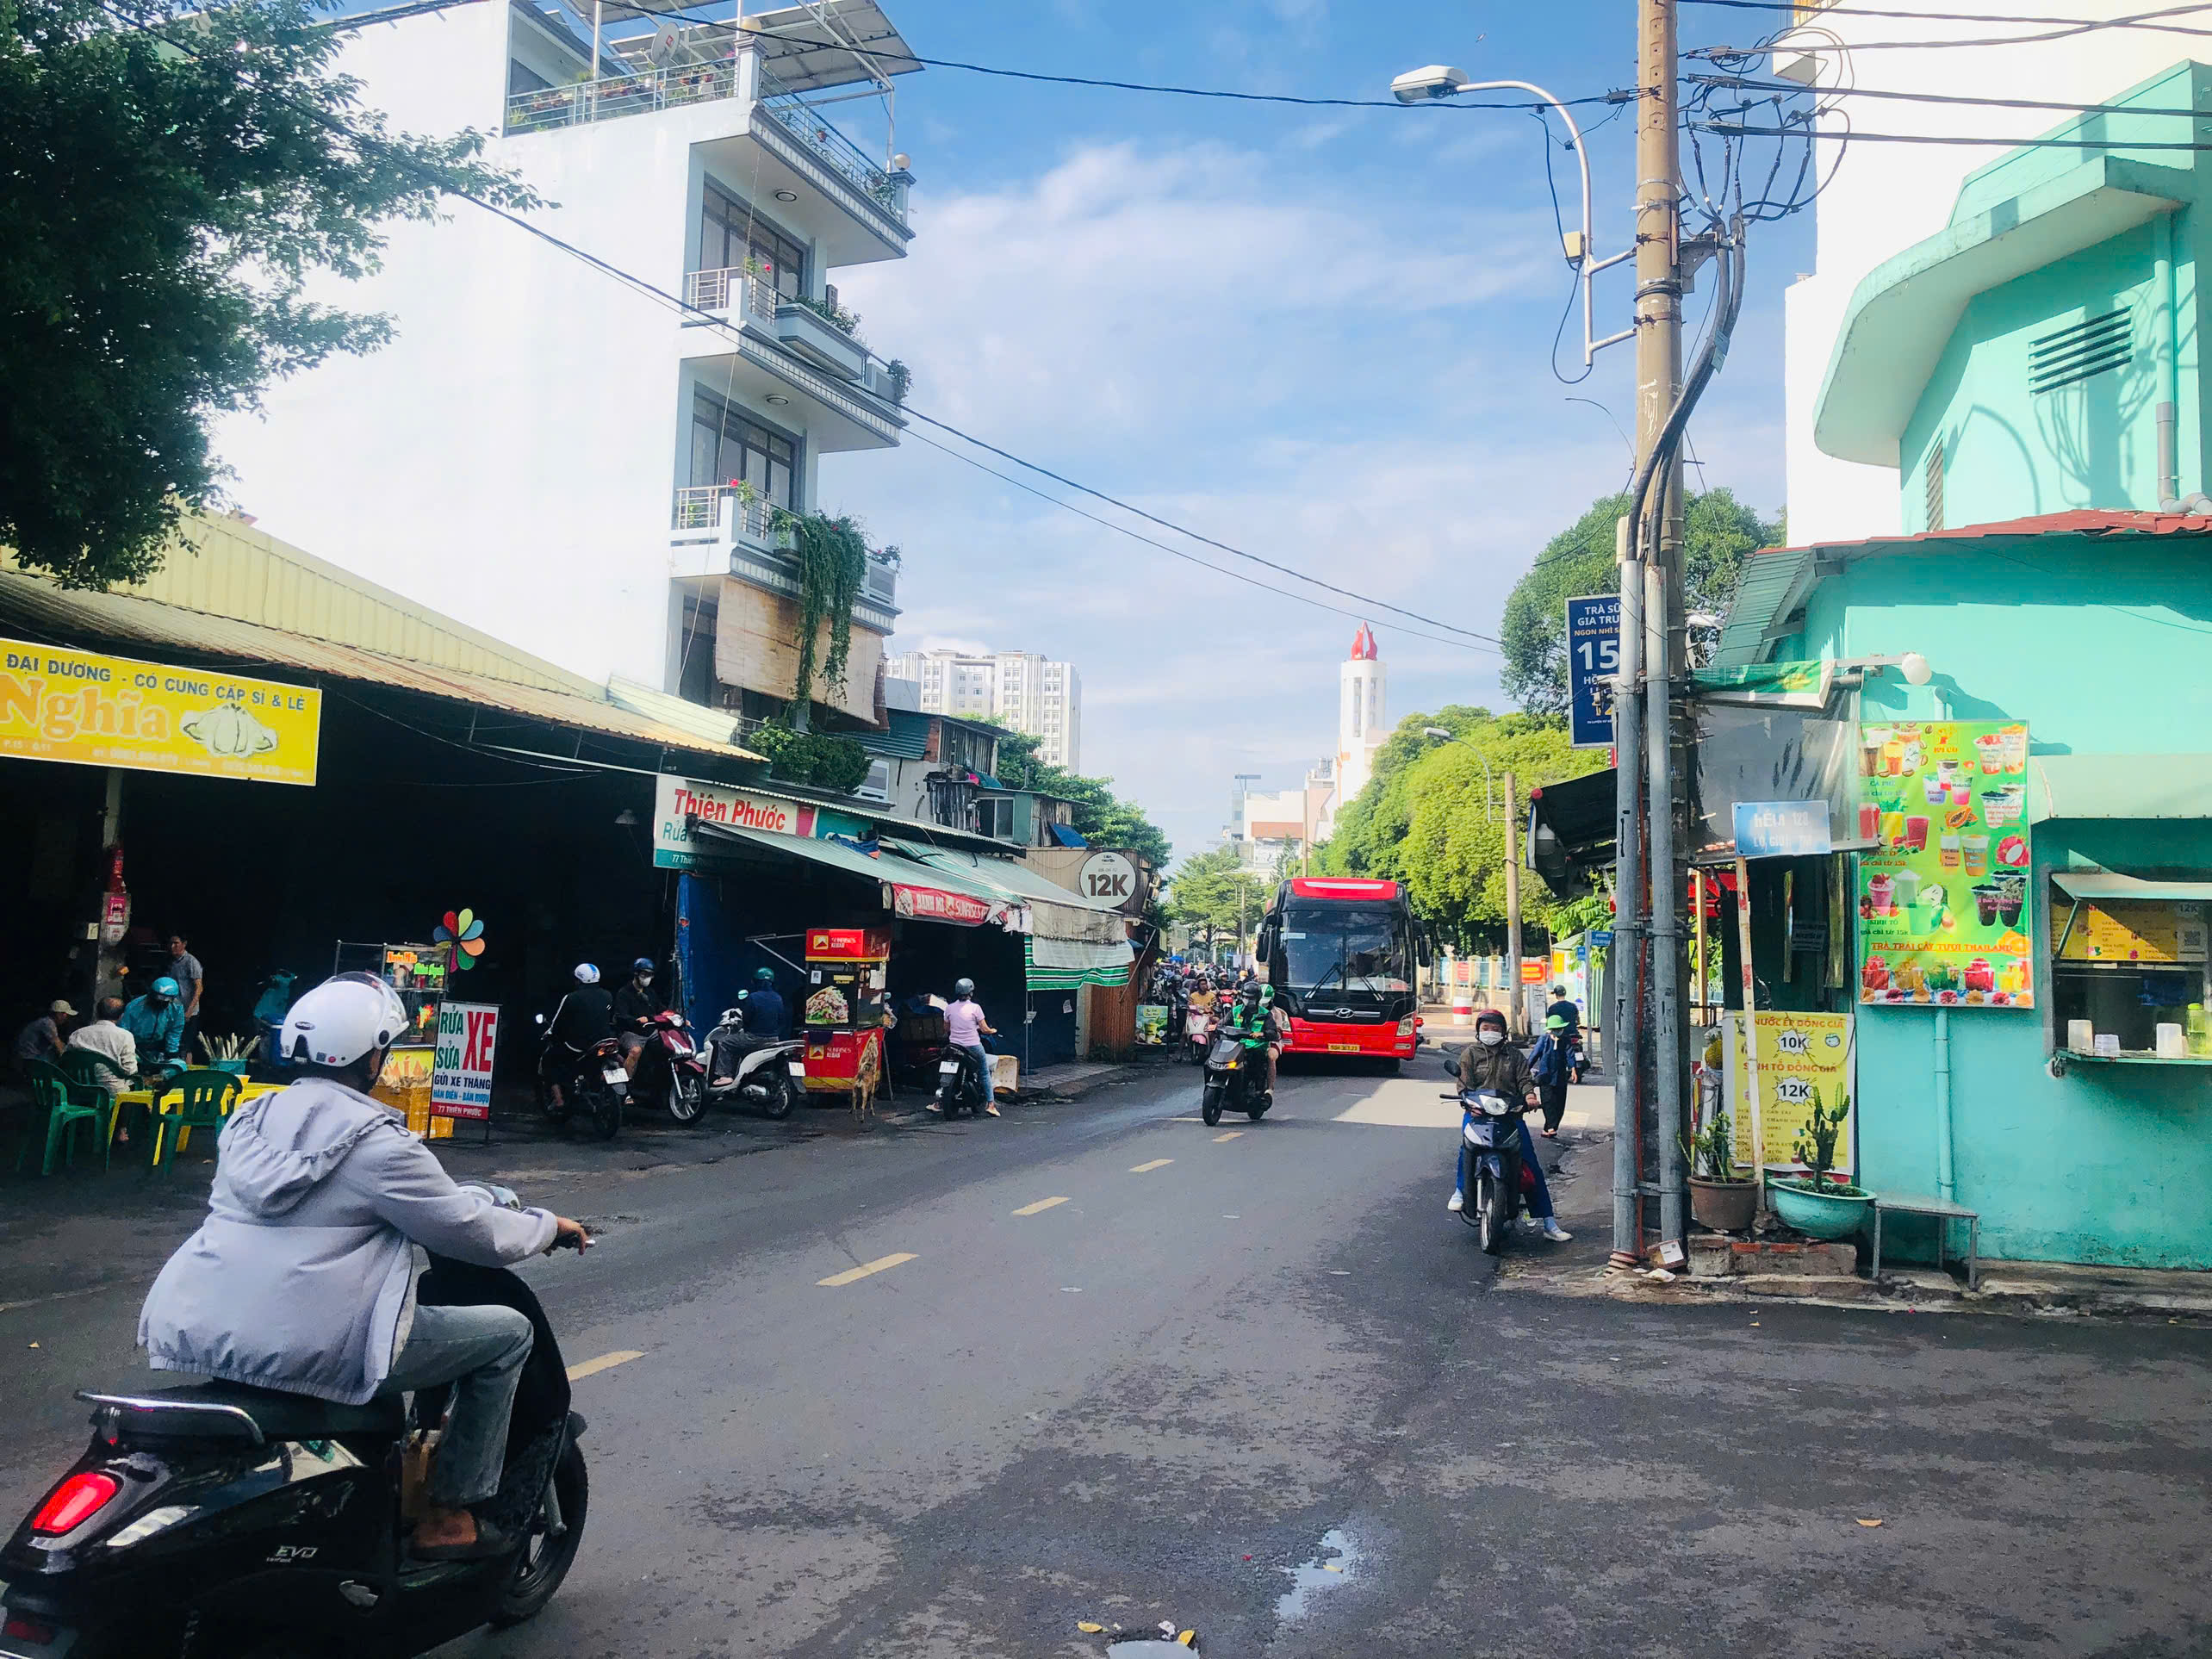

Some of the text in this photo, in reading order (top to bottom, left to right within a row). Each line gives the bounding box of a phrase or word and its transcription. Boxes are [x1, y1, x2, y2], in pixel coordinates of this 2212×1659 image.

[1585, 604, 1606, 615] TRÀ
[1577, 615, 1620, 626] GIA TRU
[1577, 639, 1619, 671] 15
[6, 653, 39, 674] ĐẠI
[47, 658, 111, 682] DƯƠNG
[165, 678, 209, 696] CUNG
[215, 683, 245, 701] CẤP
[271, 694, 282, 707] &
[0, 672, 171, 742] Nghĩa
[674, 788, 786, 830] Thiên Phước
[662, 820, 688, 842] Rửa
[1088, 874, 1128, 896] 12K
[1871, 941, 1889, 951] TRÀ
[1894, 940, 1913, 951] TRÁI
[1917, 940, 1934, 951] CÂY
[1964, 943, 2013, 952] THAILAND
[440, 1004, 496, 1072] RỬA XE
[1780, 1037, 1806, 1048] 10K
[437, 1041, 459, 1070] SỬA
[1743, 1061, 1768, 1072] SNH
[1771, 1059, 1785, 1071] TỐ
[1787, 1061, 1817, 1072] ĐỒNG
[434, 1072, 491, 1090] GỬI XE THÁNG
[1780, 1084, 1810, 1097] 12K
[276, 1545, 318, 1558] EVO
